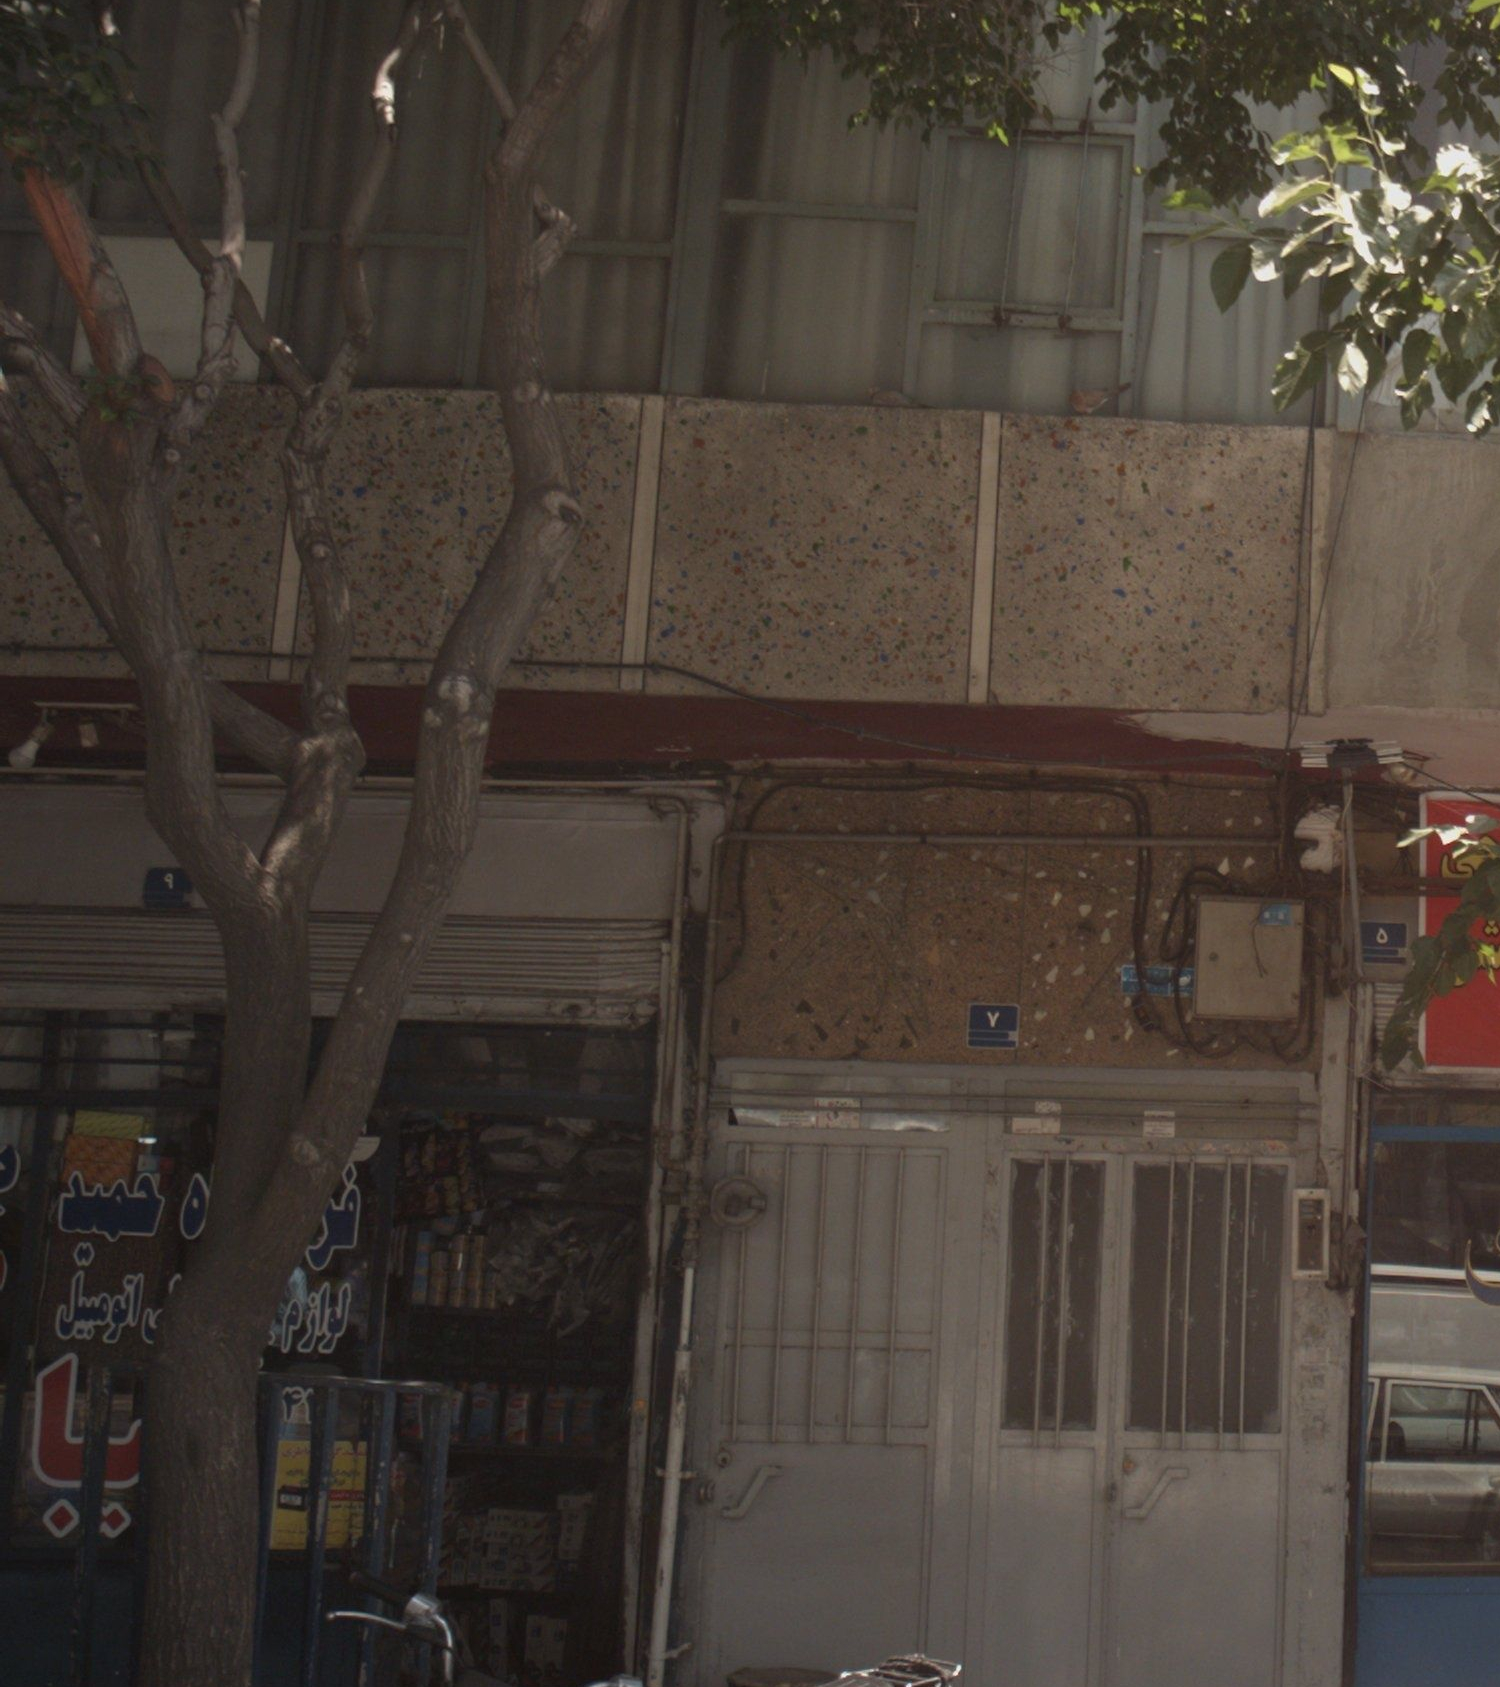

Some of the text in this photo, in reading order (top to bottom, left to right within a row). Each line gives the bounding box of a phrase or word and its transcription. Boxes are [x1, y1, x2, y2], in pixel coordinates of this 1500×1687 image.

[163, 872, 175, 890] ۹
[986, 1011, 1000, 1029] ۷
[280, 1281, 352, 1354] لوازم
